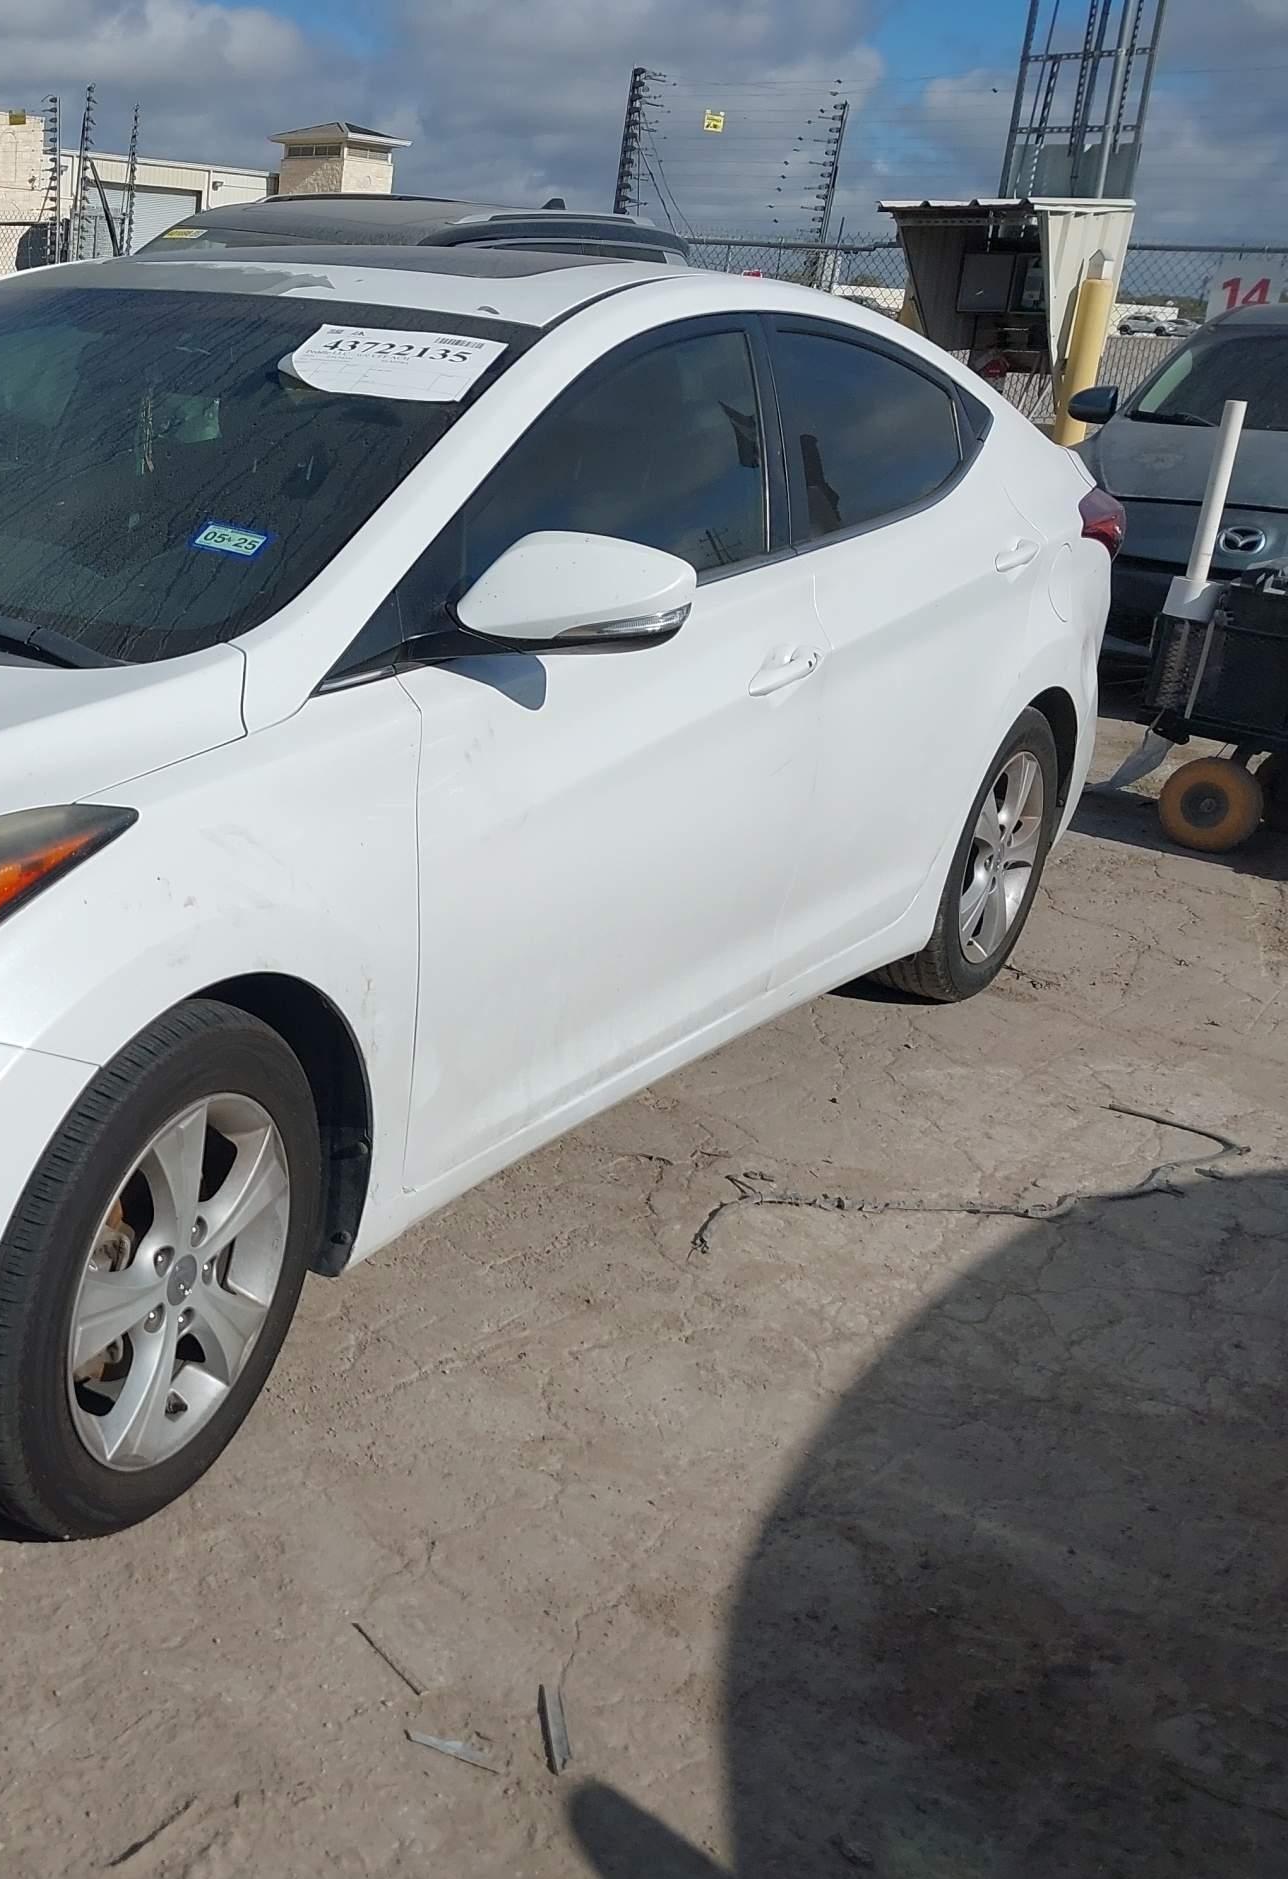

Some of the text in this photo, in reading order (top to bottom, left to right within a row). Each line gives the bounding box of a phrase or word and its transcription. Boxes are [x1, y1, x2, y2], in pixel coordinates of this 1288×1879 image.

[1222, 277, 1272, 310] 14
[323, 339, 472, 363] 43722135
[203, 531, 261, 551] 05 25
